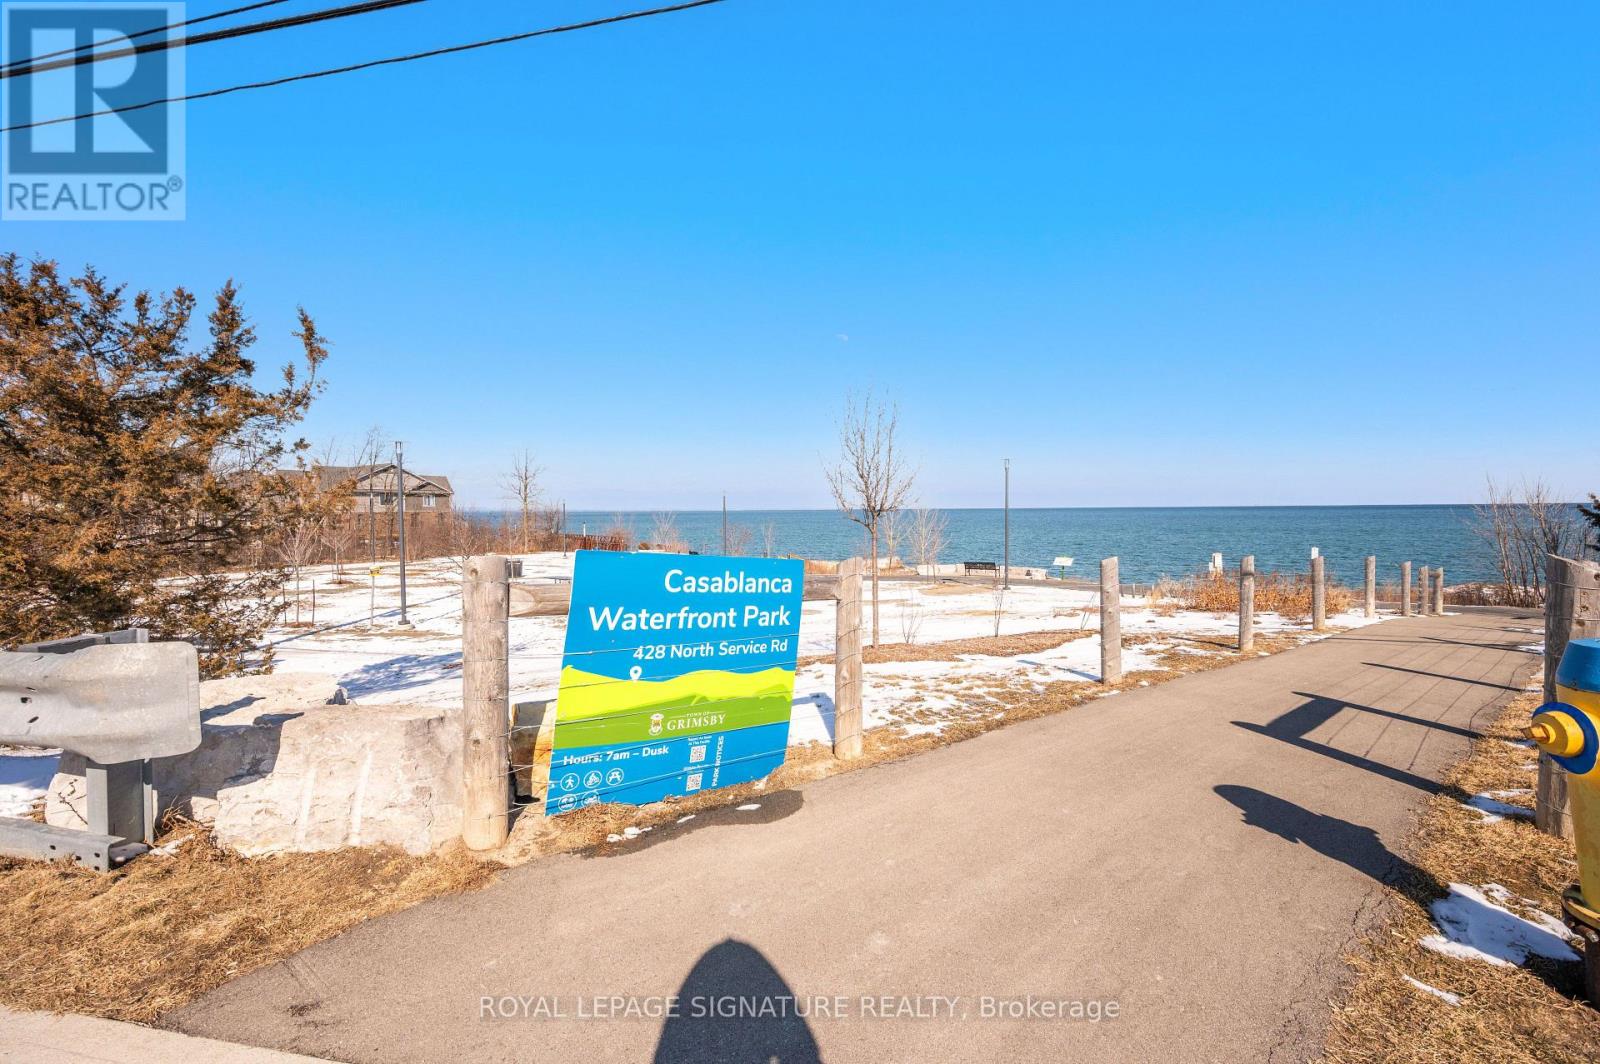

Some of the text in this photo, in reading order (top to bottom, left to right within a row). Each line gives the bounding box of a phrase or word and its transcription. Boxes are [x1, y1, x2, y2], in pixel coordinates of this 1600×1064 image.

[664, 569, 793, 594] Casablanca
[588, 605, 791, 631] Waterfront Park
[633, 639, 788, 660] 428 North Service Rd
[666, 713, 727, 731] GRIMSBY
[563, 754, 603, 766] Hours:
[606, 750, 630, 761] 7am
[642, 745, 670, 757] Dusk
[711, 735, 725, 787] PARK NOTICES
